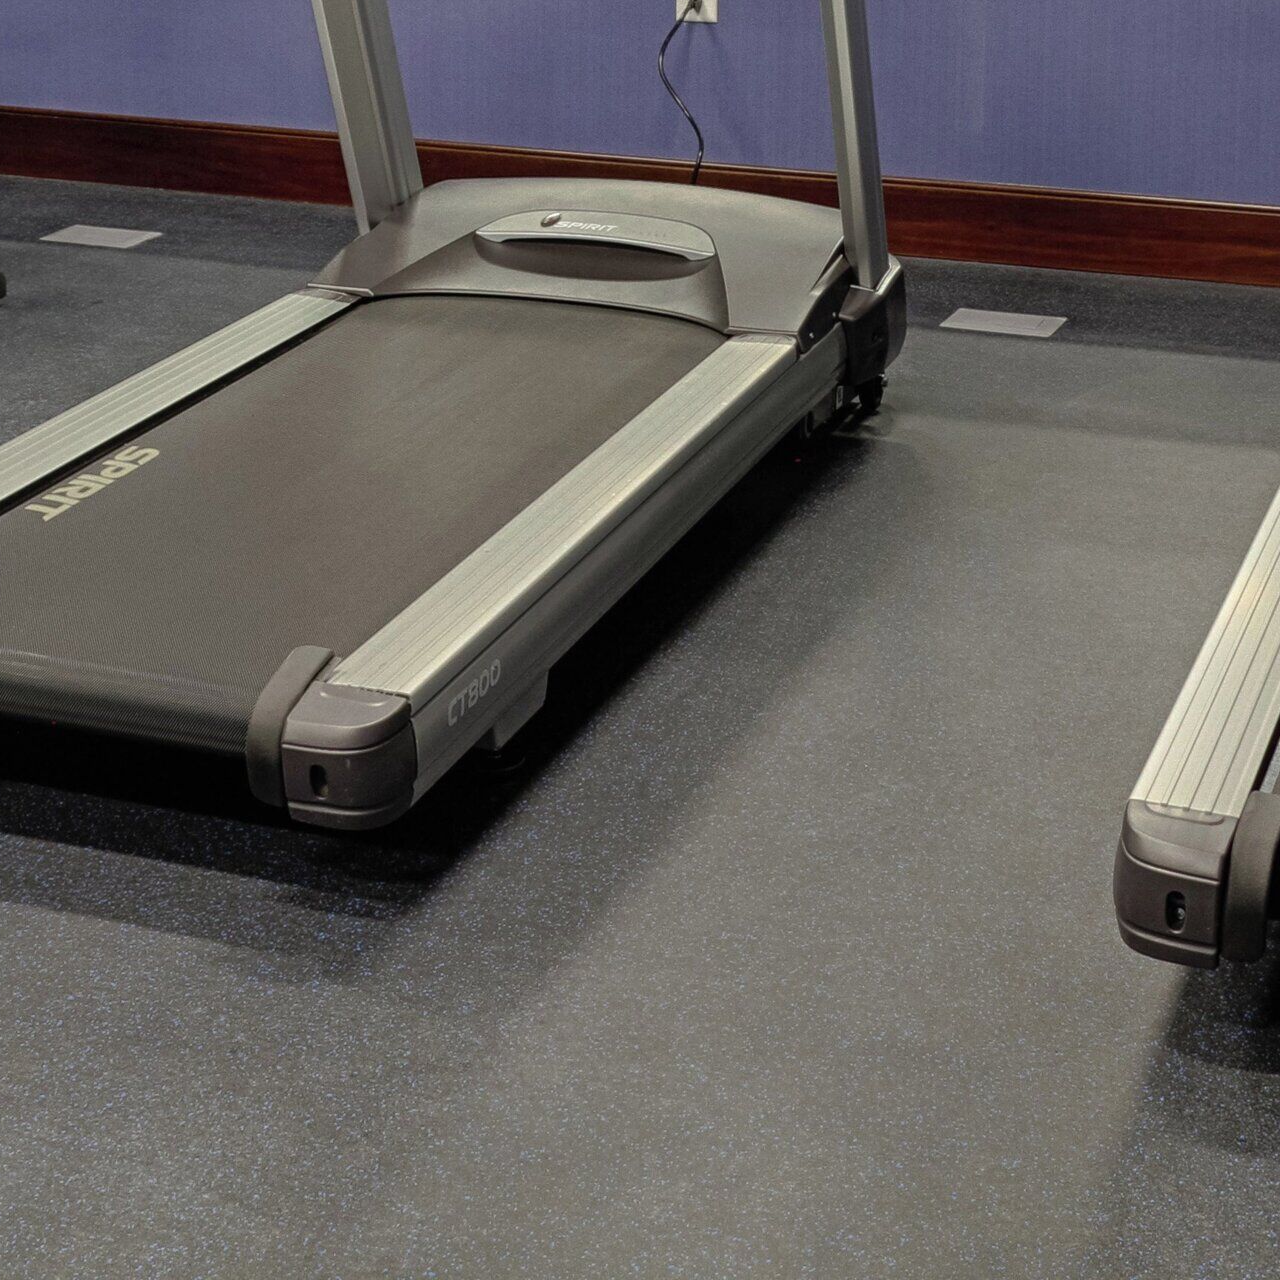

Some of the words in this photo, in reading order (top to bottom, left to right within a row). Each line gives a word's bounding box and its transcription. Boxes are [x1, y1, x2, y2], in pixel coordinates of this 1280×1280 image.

[553, 221, 618, 232] SPIRIT
[24, 445, 161, 522] SPIRIT
[447, 659, 501, 727] CT800
